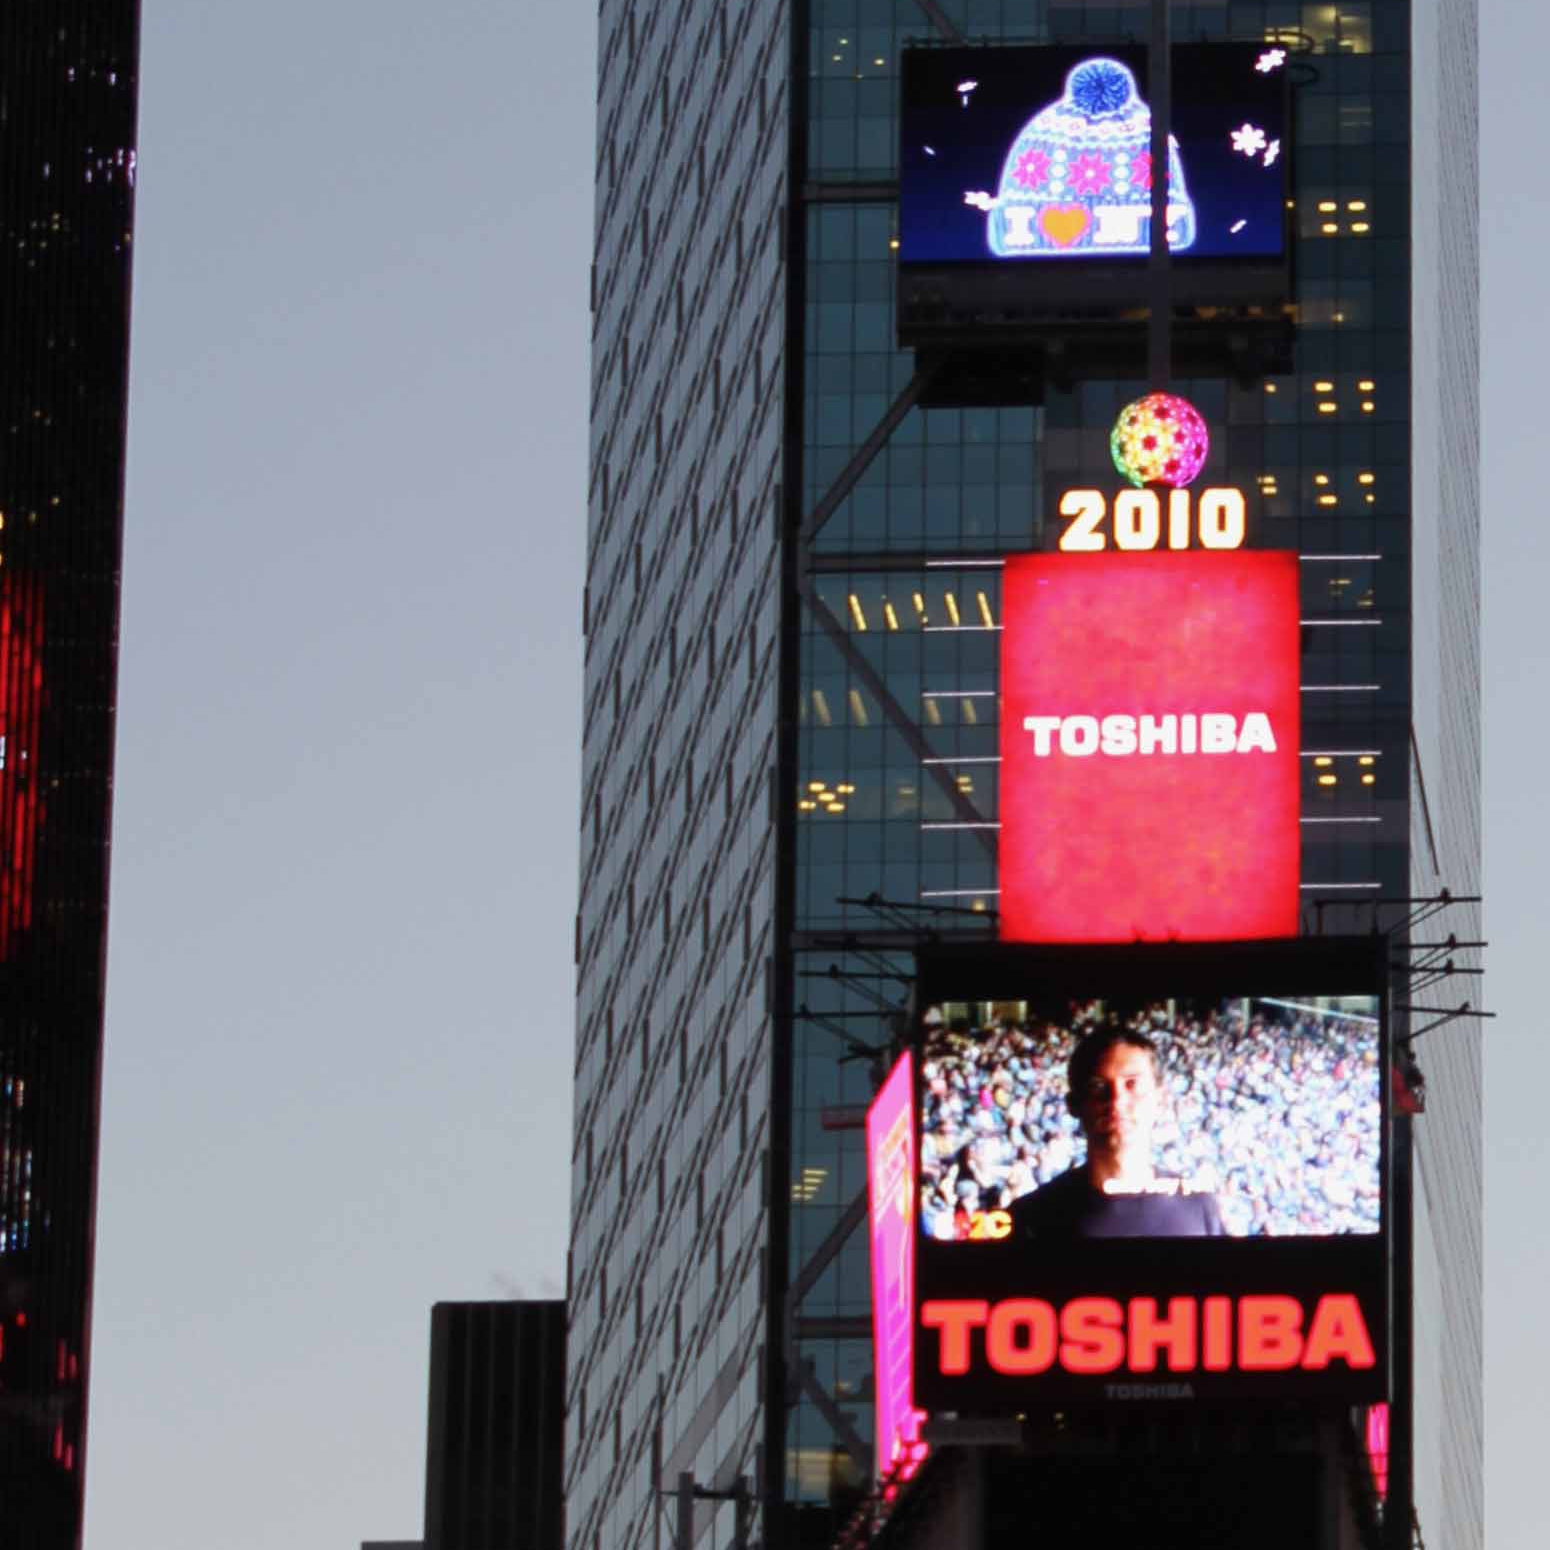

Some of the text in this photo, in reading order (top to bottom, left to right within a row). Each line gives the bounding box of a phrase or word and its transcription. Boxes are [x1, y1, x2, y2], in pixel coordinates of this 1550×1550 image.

[1059, 487, 1245, 552] 2010
[1023, 712, 1277, 757] TOSHIBA
[920, 1294, 1377, 1376] TOSHIBA
[1104, 1383, 1195, 1399] TOSHIBA
